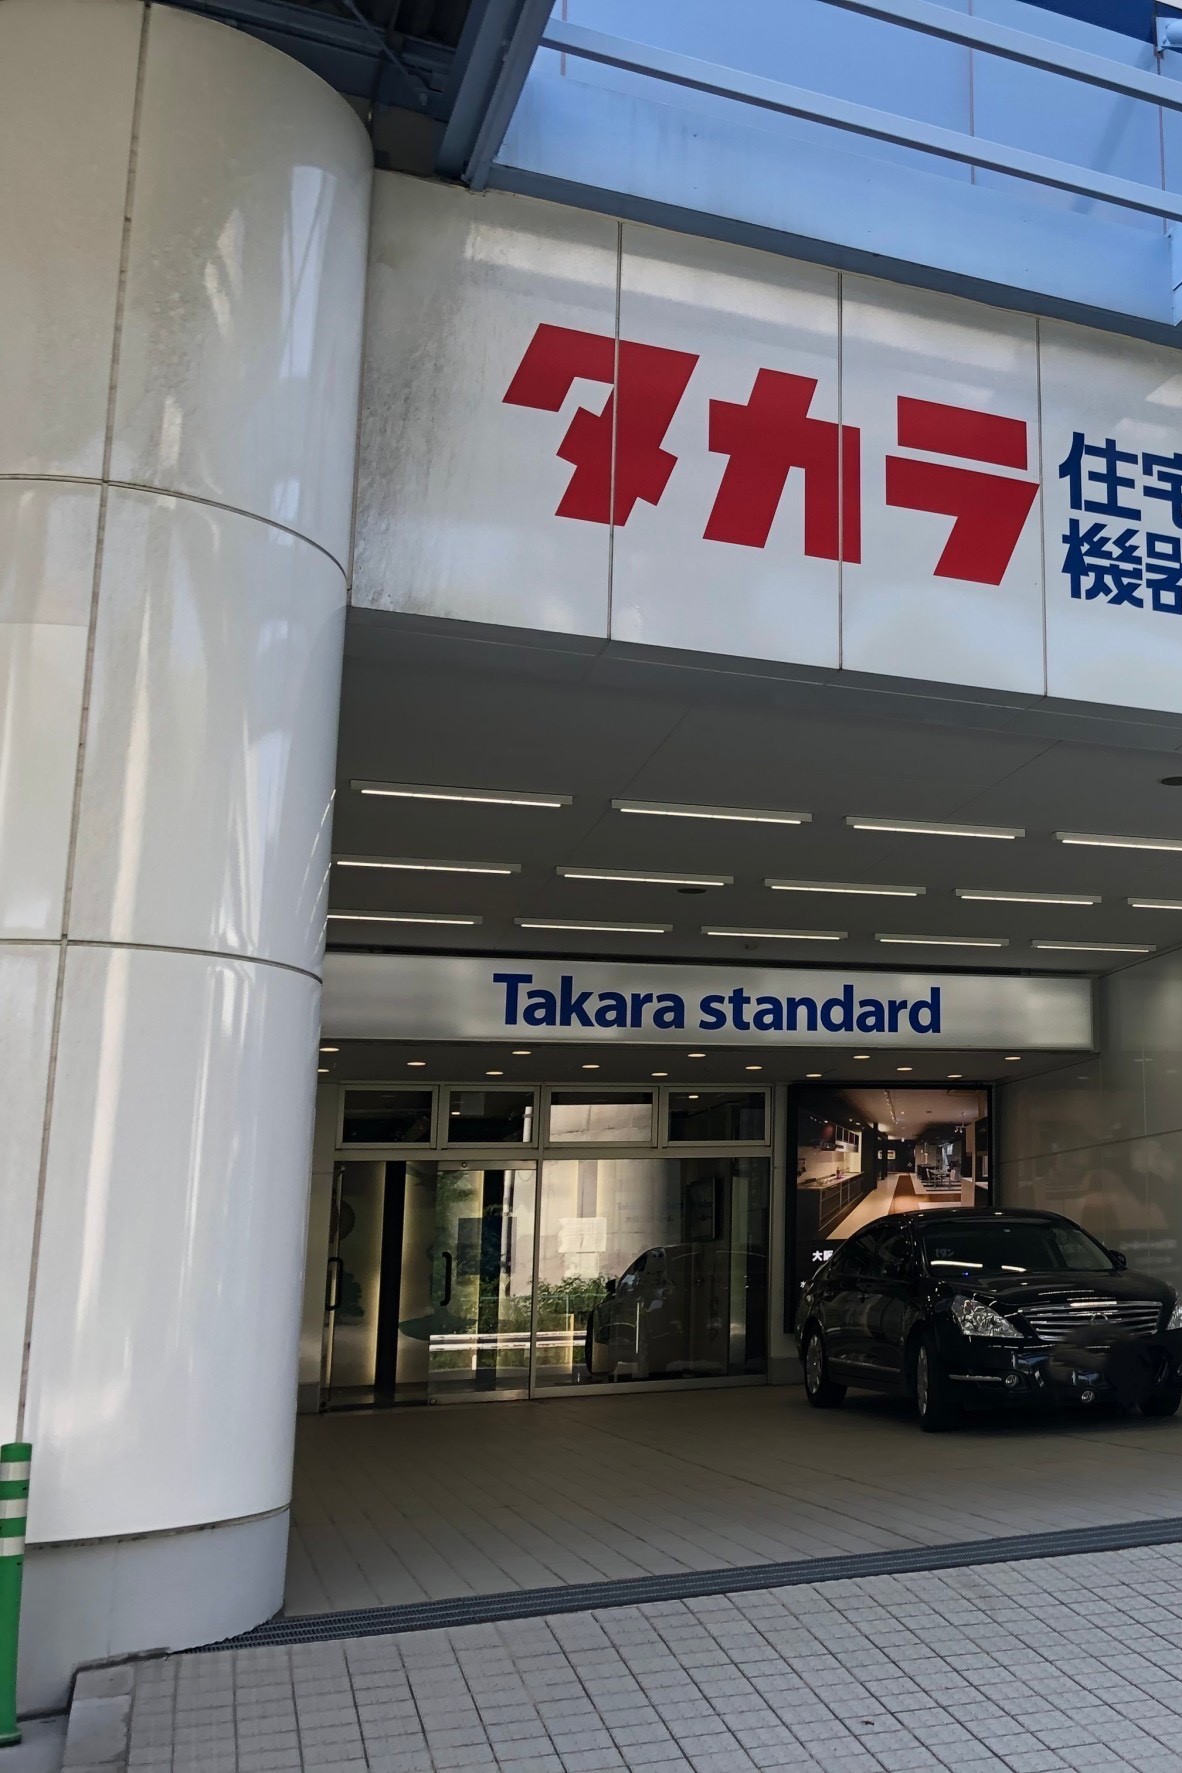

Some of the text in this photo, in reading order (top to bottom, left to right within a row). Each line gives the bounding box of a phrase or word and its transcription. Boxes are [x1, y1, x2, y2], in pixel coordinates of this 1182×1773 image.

[502, 323, 1040, 586] タカラ
[493, 973, 941, 1034] Takara standard
